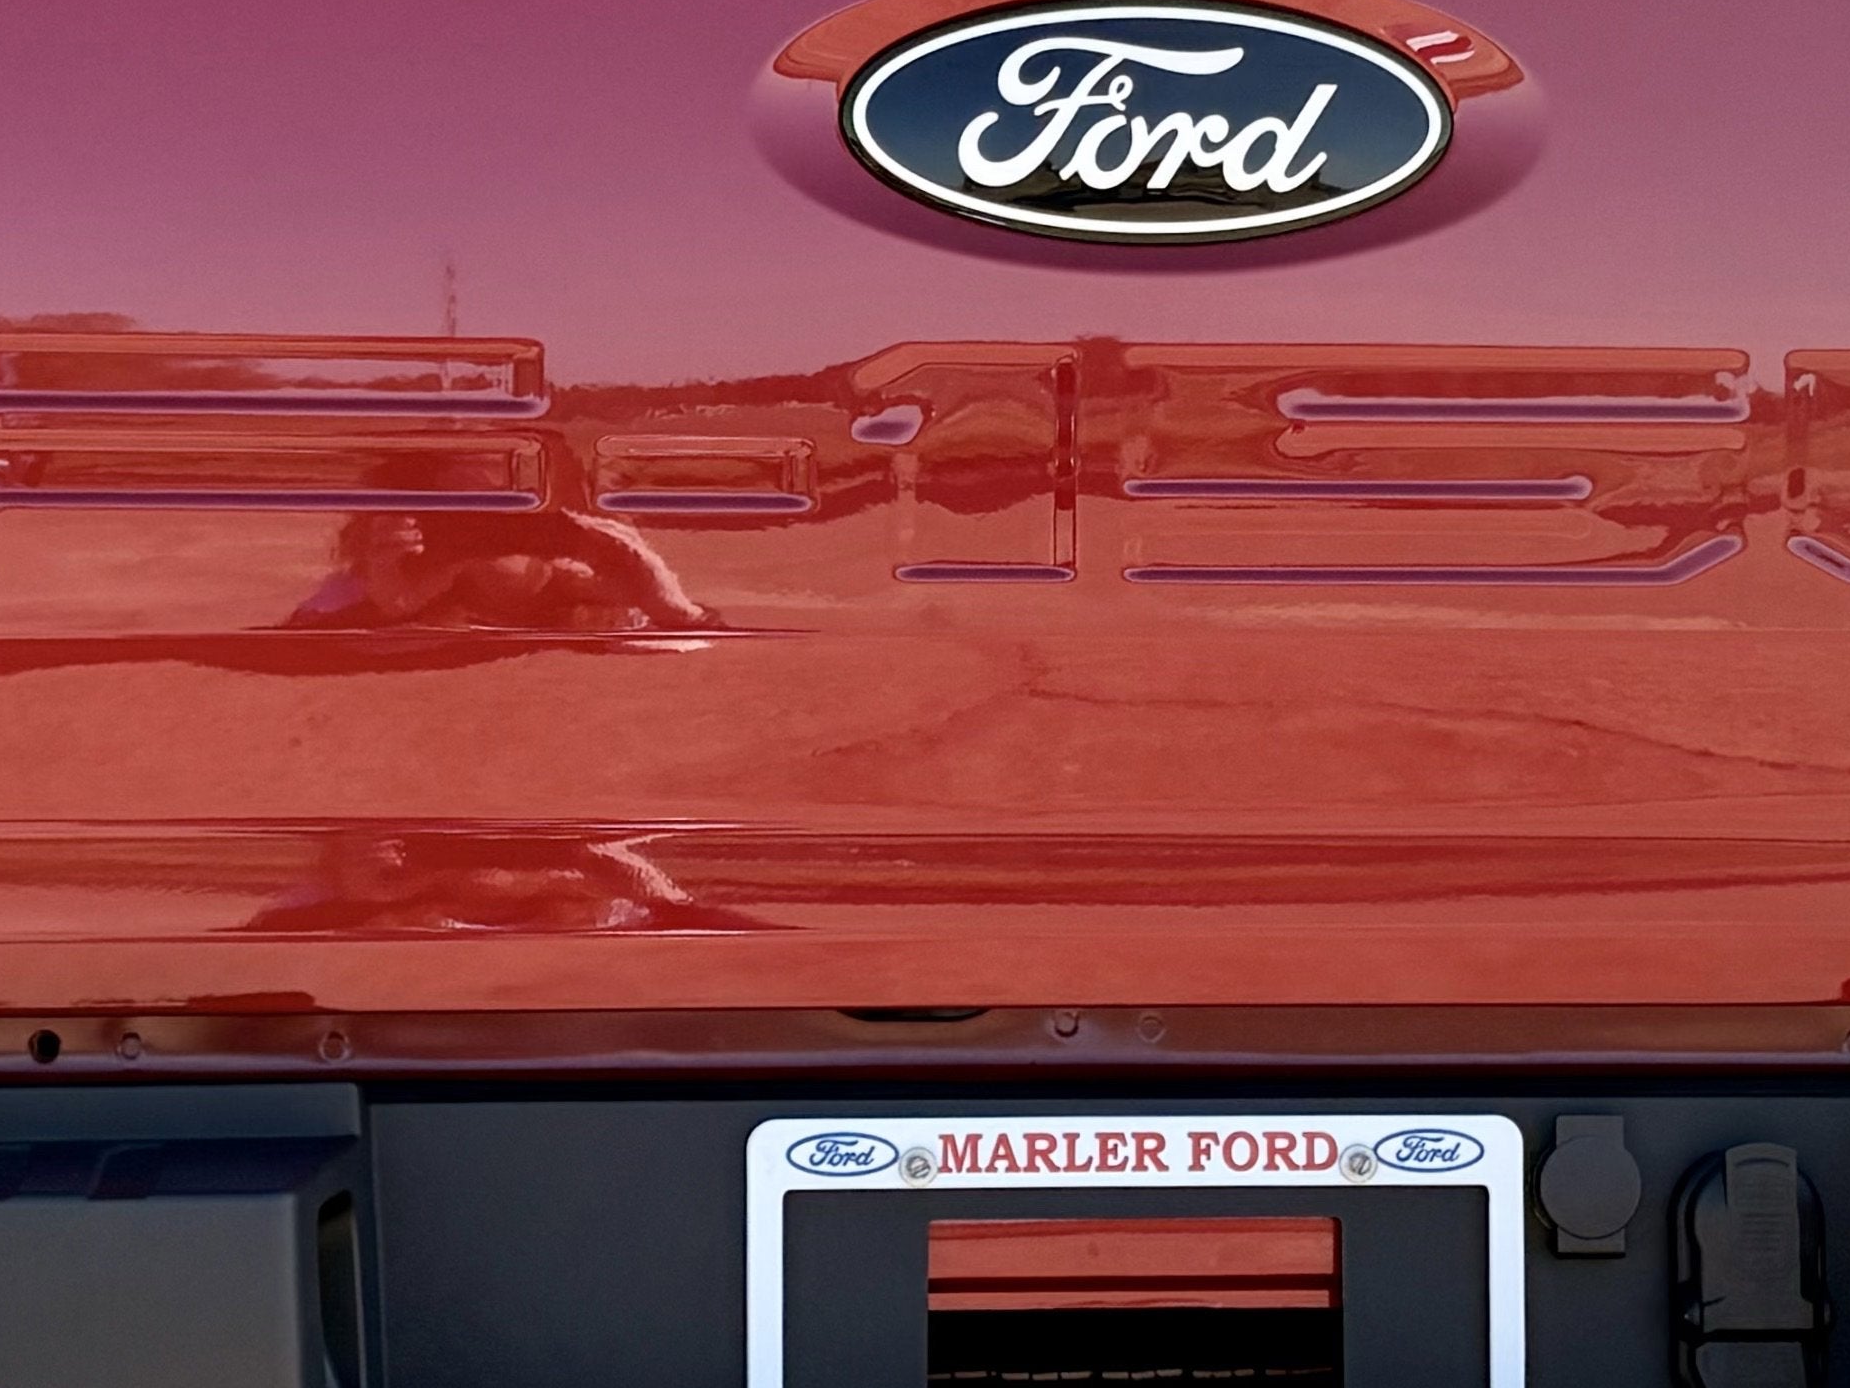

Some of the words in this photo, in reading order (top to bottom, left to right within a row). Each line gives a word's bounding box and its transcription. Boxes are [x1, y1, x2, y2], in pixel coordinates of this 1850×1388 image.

[957, 37, 1339, 193] Ford
[809, 1138, 875, 1167] Ford
[938, 1132, 1169, 1174] MARLER
[1187, 1131, 1339, 1172] FORD
[1395, 1135, 1461, 1163] Ford
